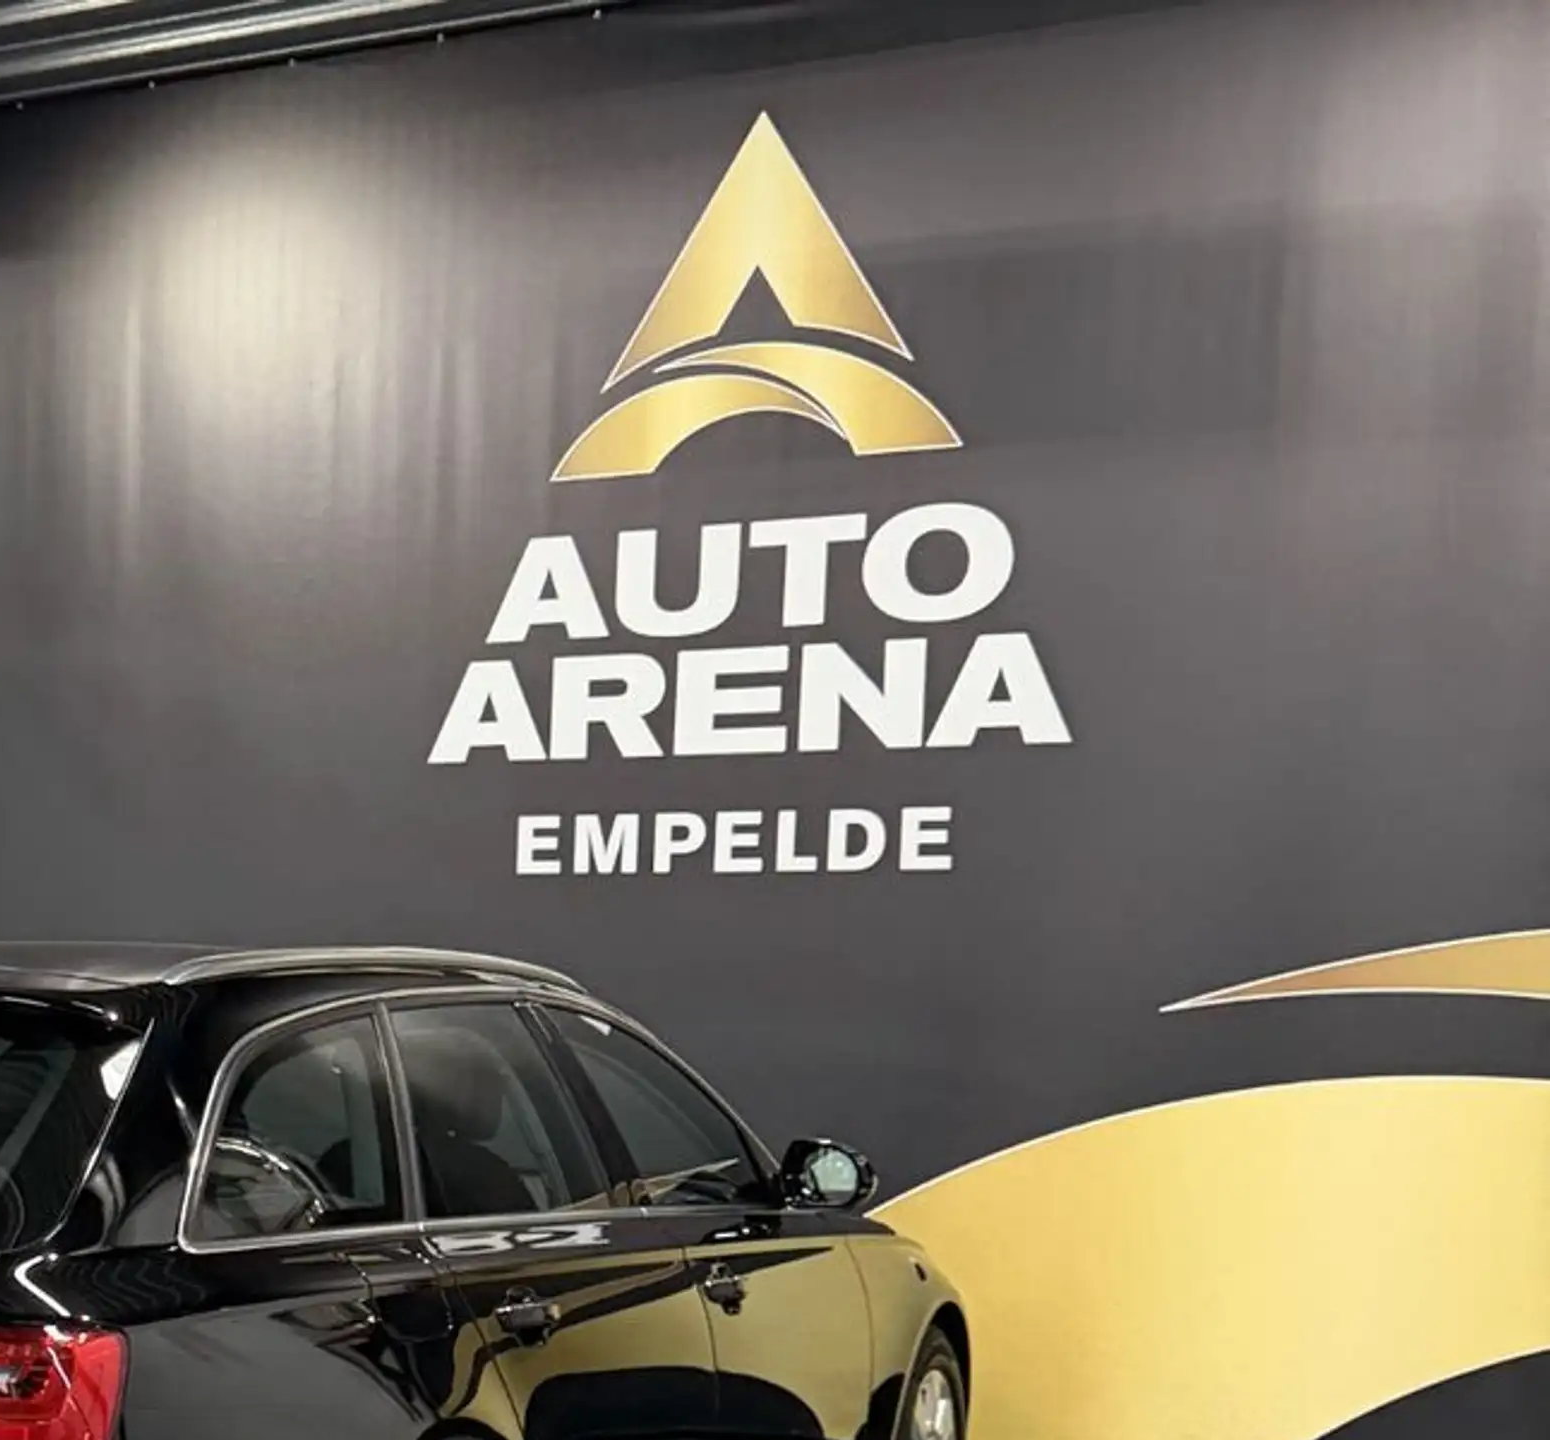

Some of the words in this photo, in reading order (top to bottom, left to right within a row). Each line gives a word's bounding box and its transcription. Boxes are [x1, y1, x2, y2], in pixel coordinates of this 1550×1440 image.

[485, 501, 1015, 645] AUTO
[426, 631, 1074, 764] ARENA
[515, 806, 954, 875] EMPELDE
